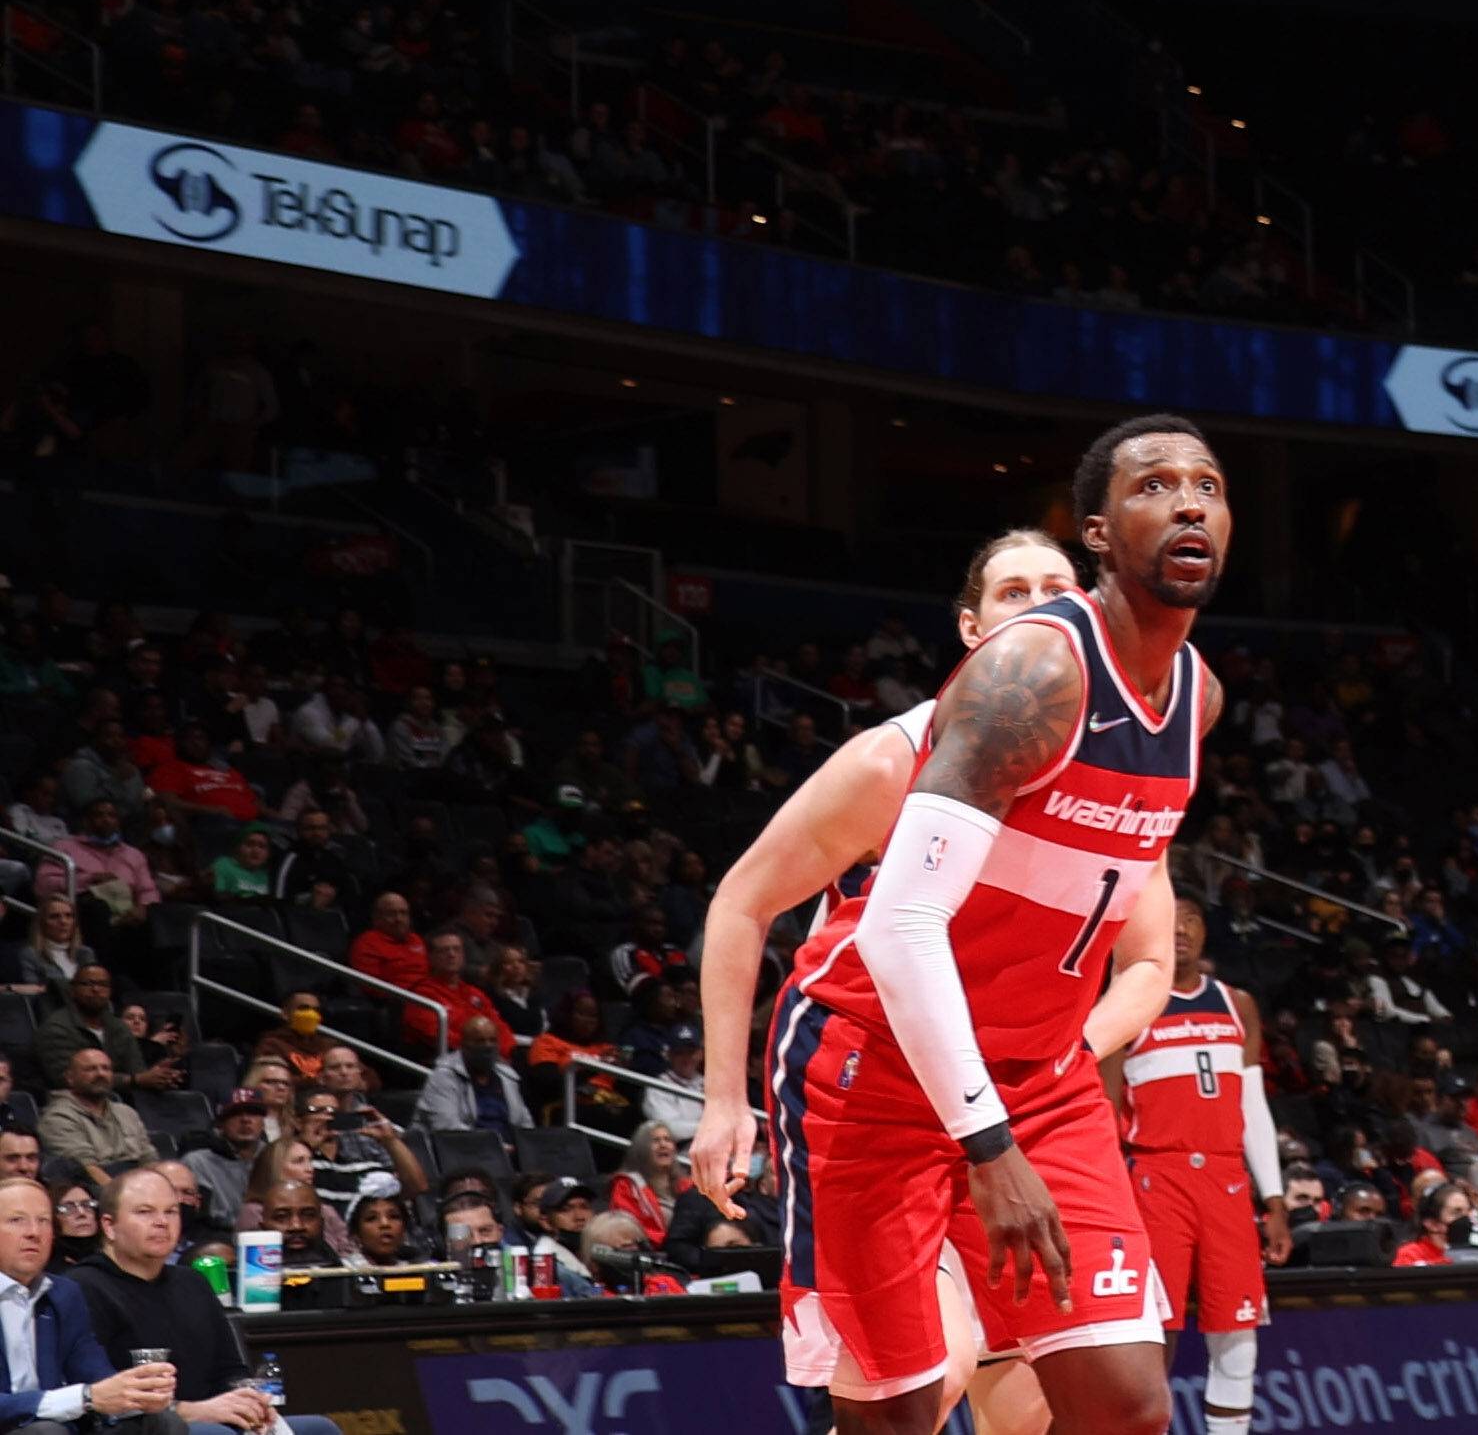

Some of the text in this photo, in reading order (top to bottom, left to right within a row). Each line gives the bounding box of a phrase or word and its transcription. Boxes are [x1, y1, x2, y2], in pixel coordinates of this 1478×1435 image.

[1043, 791, 1187, 849] washingto
[1058, 866, 1122, 977] 1
[1195, 1050, 1217, 1097] 8
